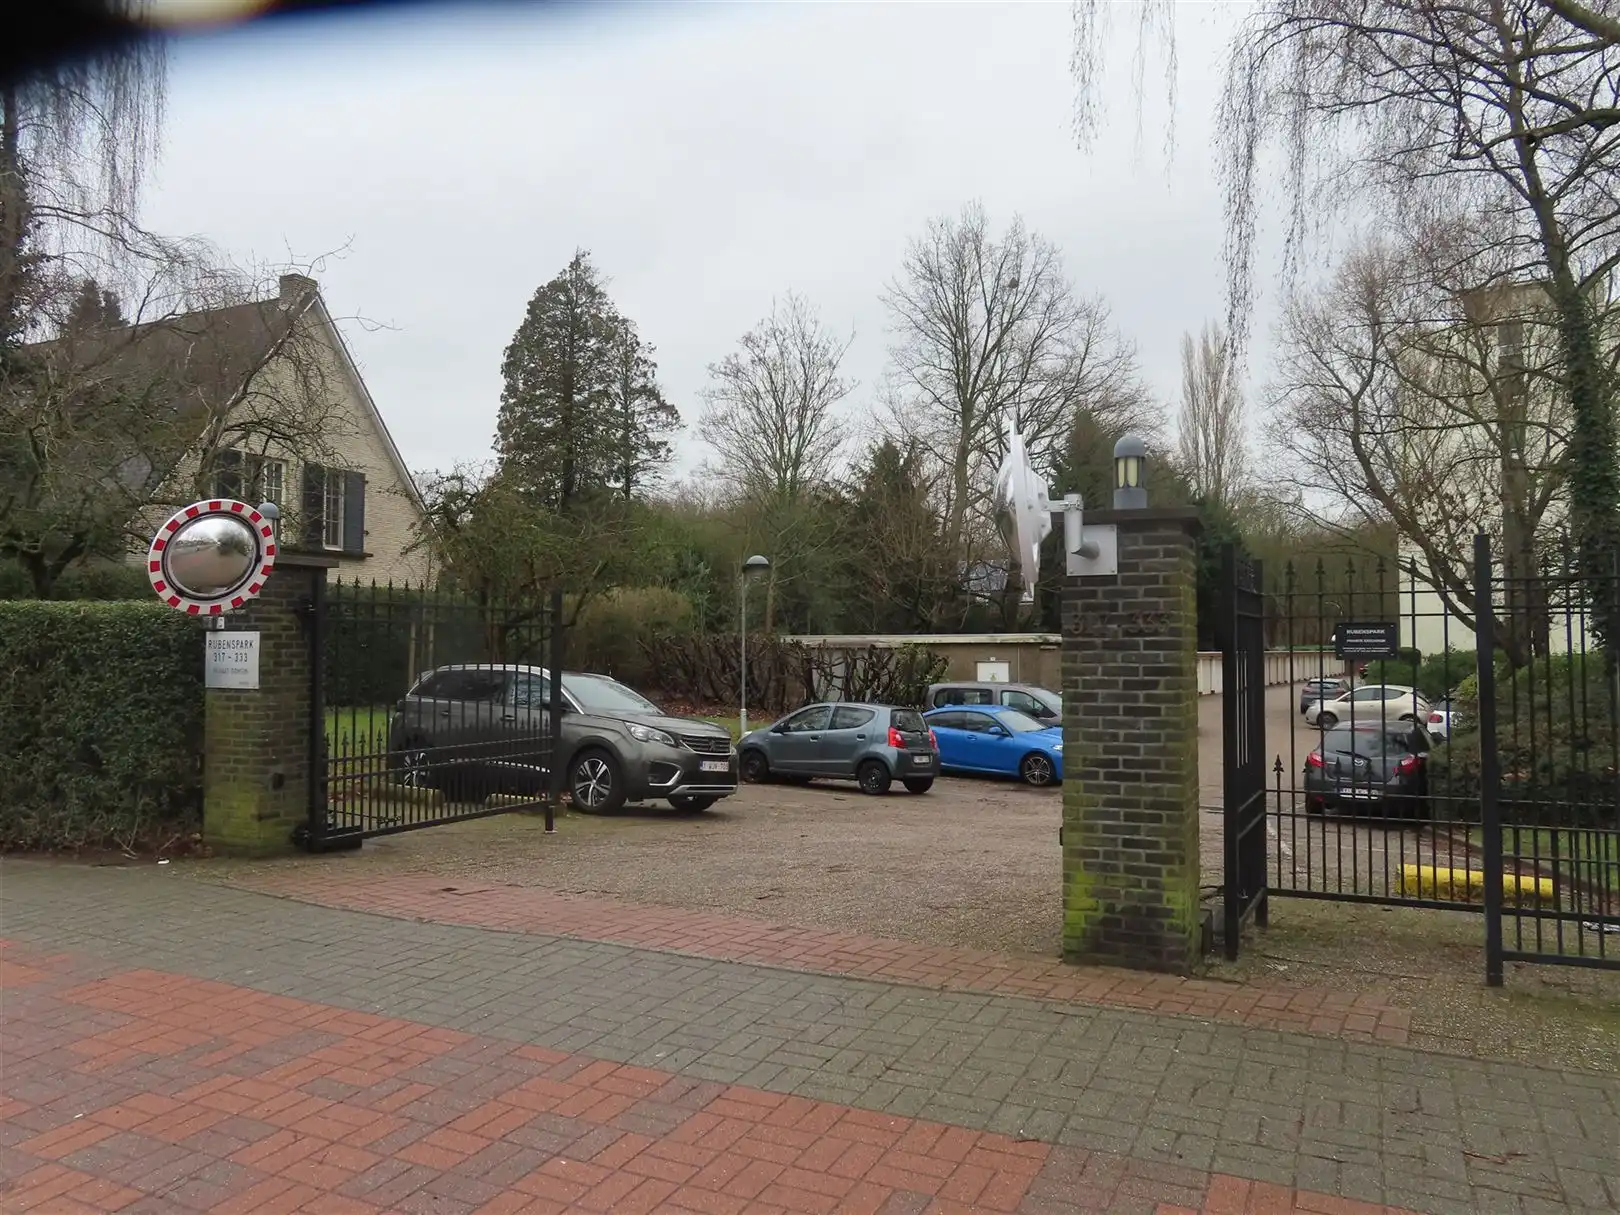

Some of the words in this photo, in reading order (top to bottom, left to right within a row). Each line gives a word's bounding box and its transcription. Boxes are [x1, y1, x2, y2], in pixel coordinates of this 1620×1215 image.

[208, 639, 254, 650] RUBENSPARK
[213, 652, 226, 662] 317
[234, 652, 248, 662] 333
